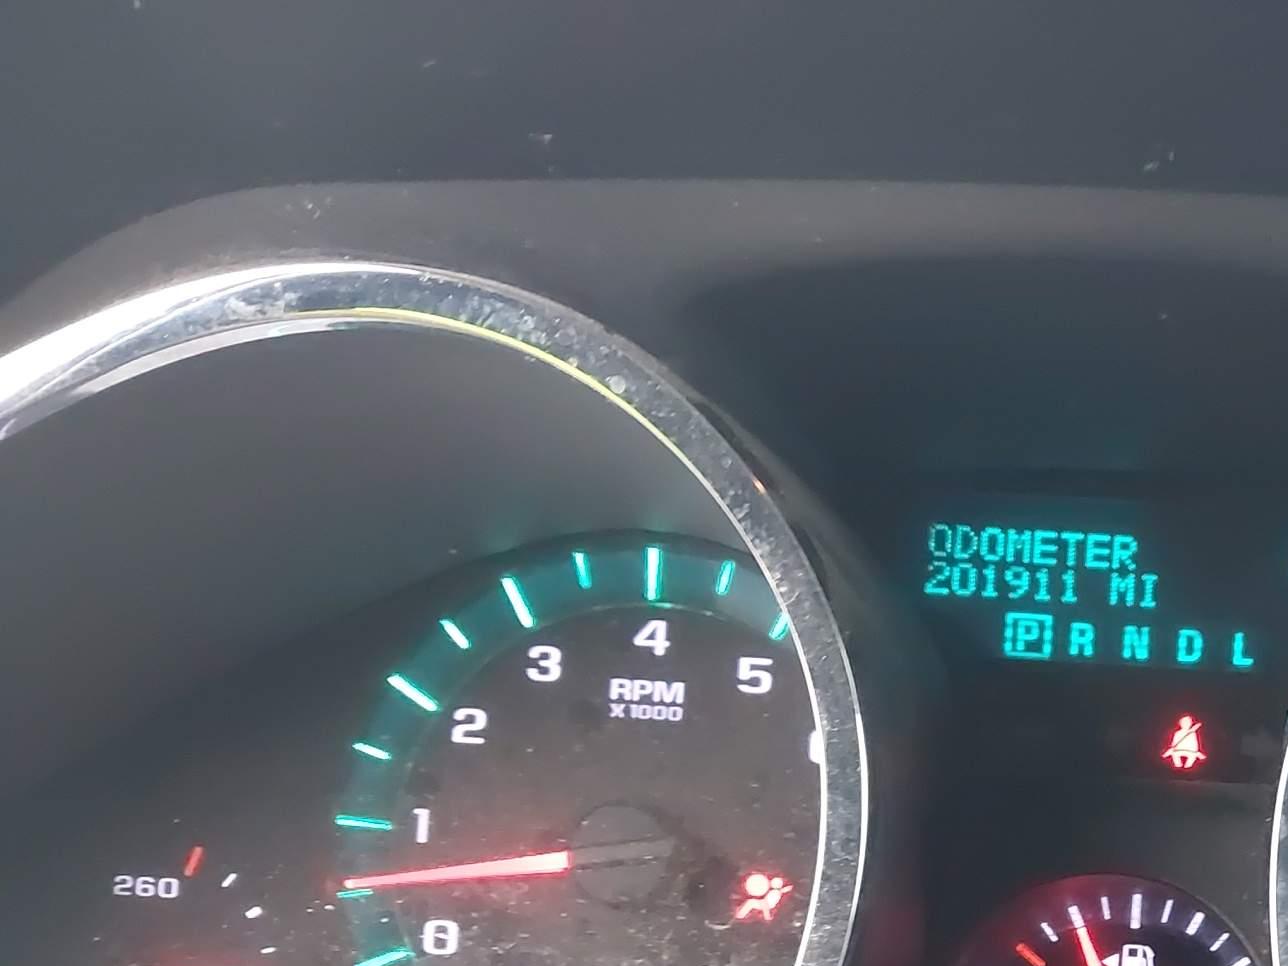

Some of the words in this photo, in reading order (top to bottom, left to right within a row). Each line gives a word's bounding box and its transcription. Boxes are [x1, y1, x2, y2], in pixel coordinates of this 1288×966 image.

[928, 523, 1137, 569] ODOMETER
[924, 562, 1078, 602] 201911
[1109, 573, 1159, 607] MI
[633, 619, 671, 656] 4
[1018, 621, 1039, 651] P
[1069, 623, 1094, 656] R
[1123, 626, 1149, 659] N
[1177, 630, 1202, 662] D
[1232, 633, 1254, 666] L
[526, 646, 562, 682] 3
[737, 657, 773, 695] 5
[609, 678, 685, 706] RPM
[451, 709, 487, 744] 2
[412, 809, 430, 843] 1
[112, 875, 180, 900] 260
[422, 920, 459, 955] 0
